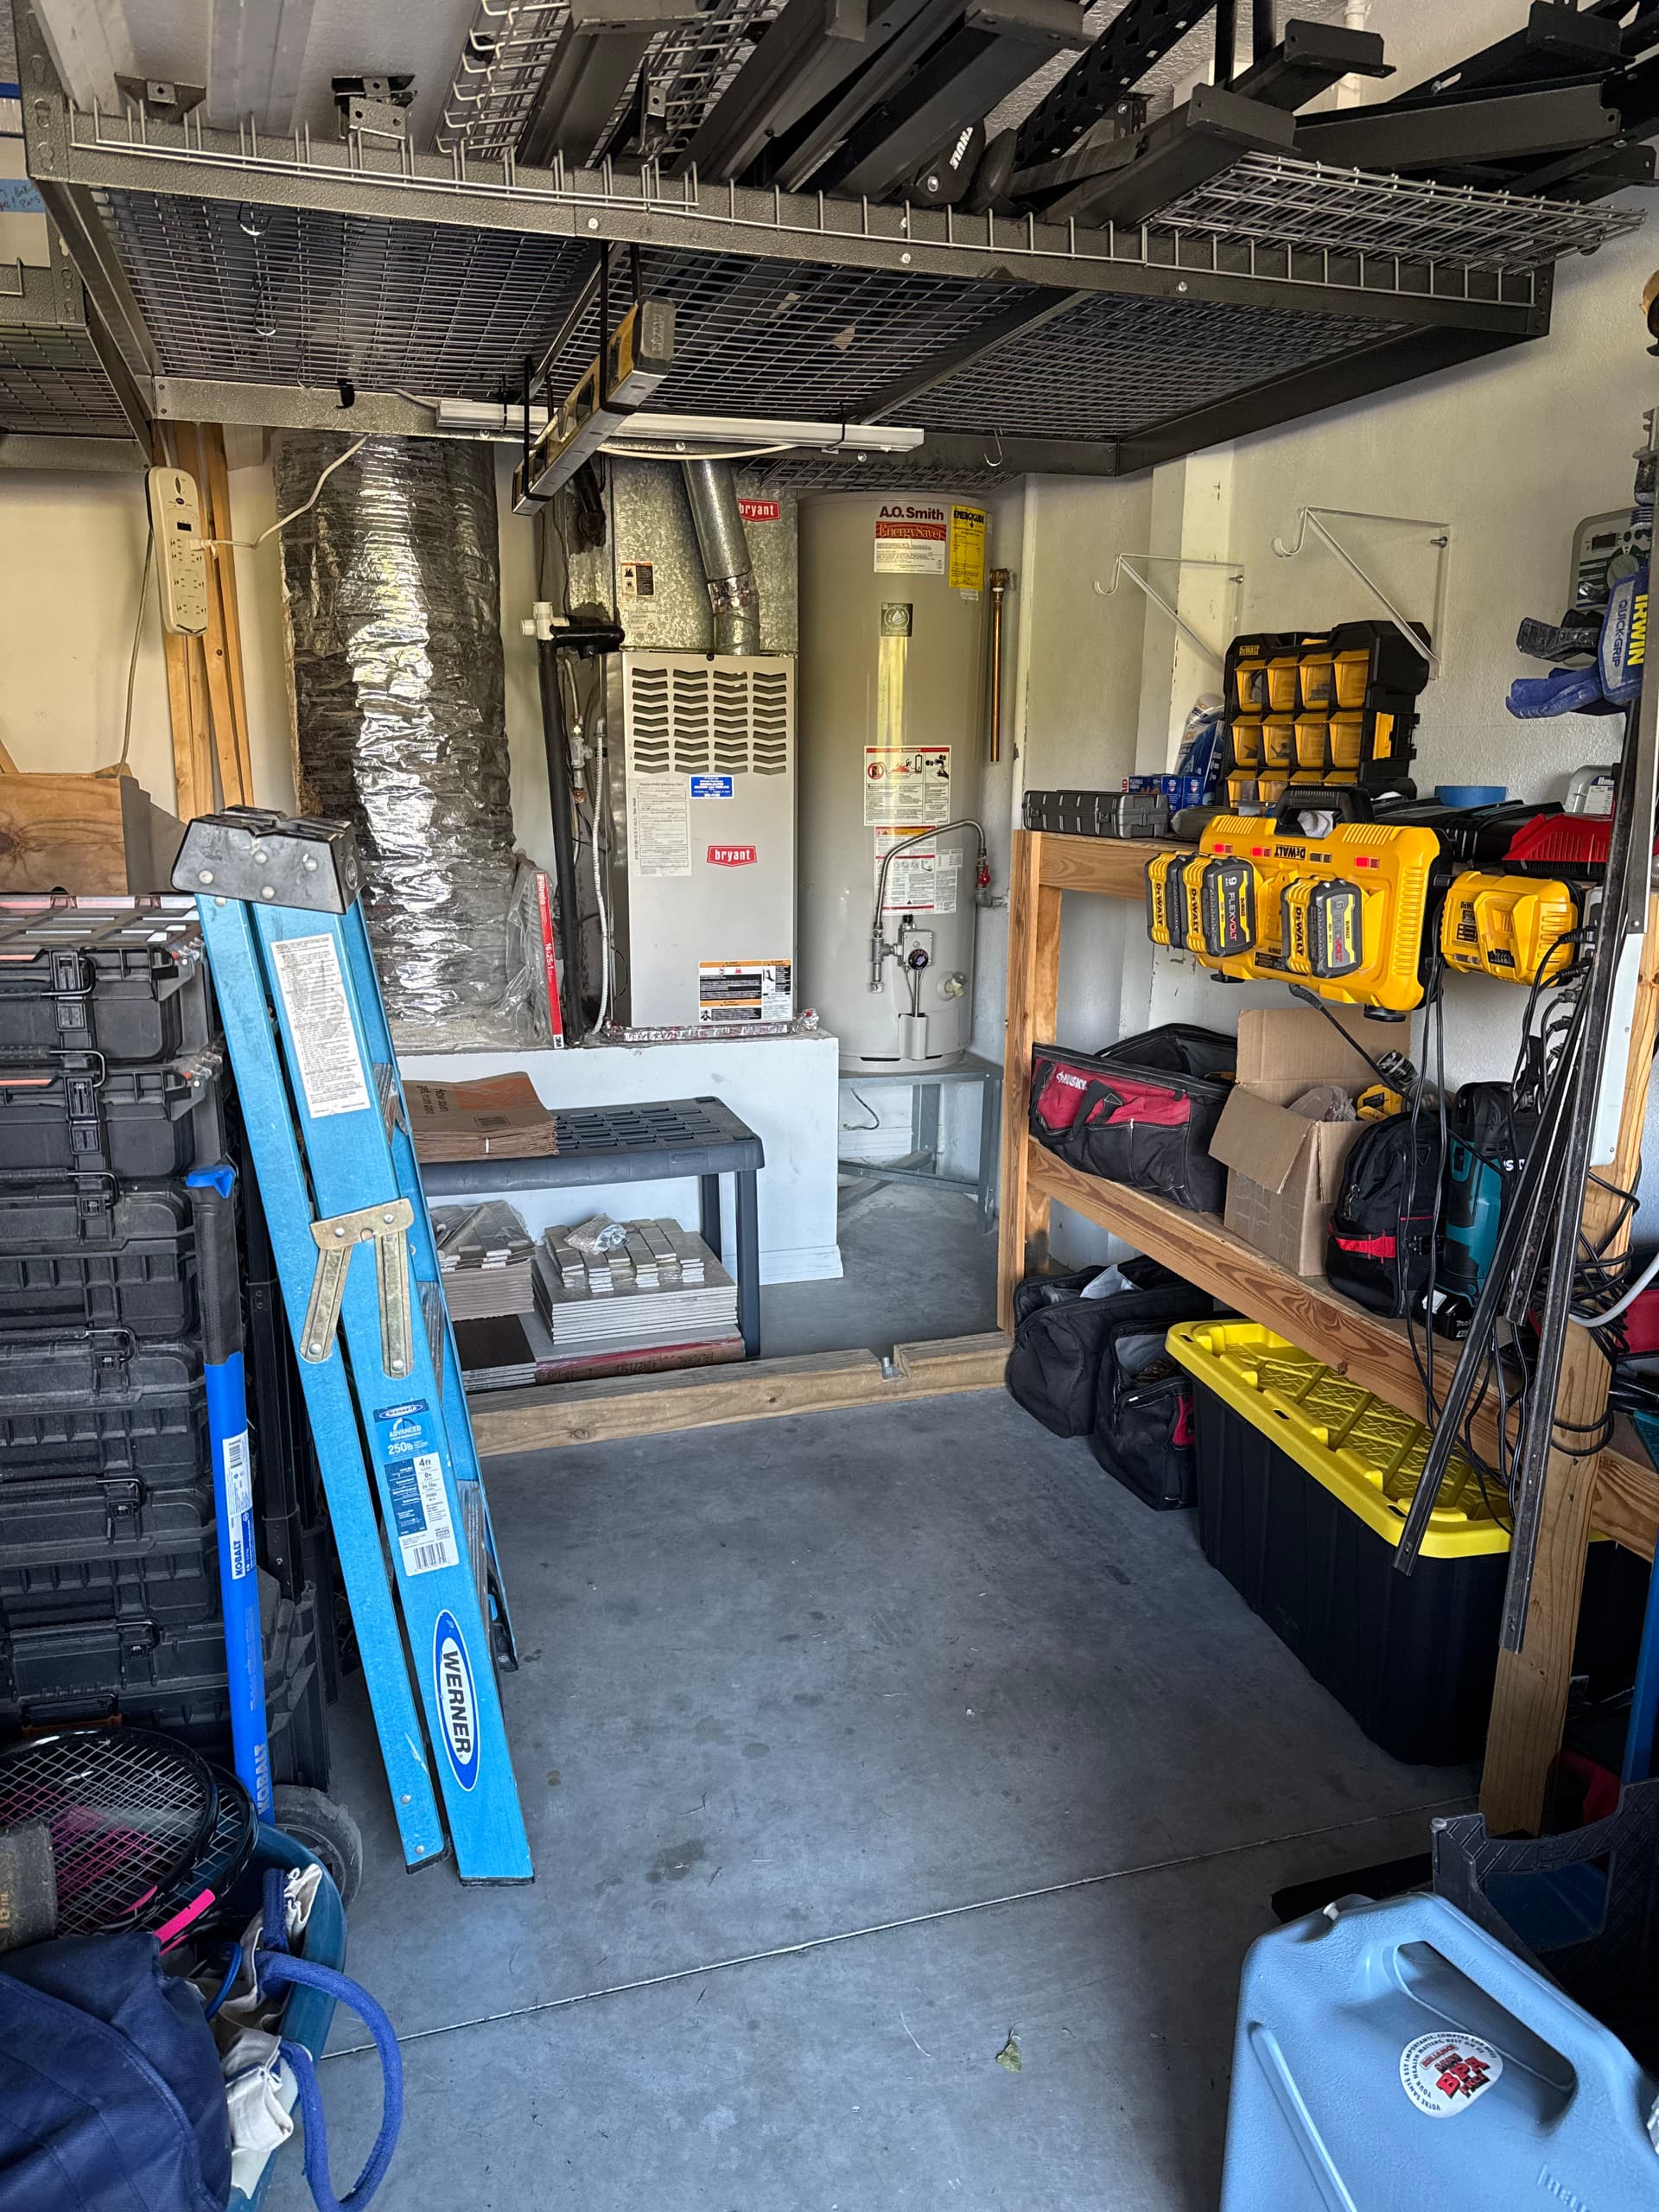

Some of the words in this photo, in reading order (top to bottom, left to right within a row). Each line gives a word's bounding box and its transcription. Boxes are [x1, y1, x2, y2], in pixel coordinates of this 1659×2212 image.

[949, 127, 974, 170] THULE
[739, 503, 774, 517] bryant
[880, 506, 905, 518] A.O.
[906, 507, 944, 520] Smith
[1627, 594, 1649, 666] IRWIN
[715, 849, 751, 862] bryant
[1274, 845, 1306, 860] DEWALT
[1228, 876, 1237, 886] 9
[1228, 892, 1237, 941] FLEXVOLT
[1295, 906, 1305, 957] DEWALT
[555, 1035, 562, 1048] 3M
[1063, 1072, 1087, 1090] HUSKY
[389, 1425, 422, 1439] ADVANCED
[233, 1541, 243, 1576] KOBALT
[443, 1650, 472, 1754] WERNER
[254, 1743, 270, 1815] KOBALT
[1435, 2056, 1491, 2100] BPA
[1459, 2074, 1491, 2099] FREE
[1415, 2081, 1432, 2098] YOUR
